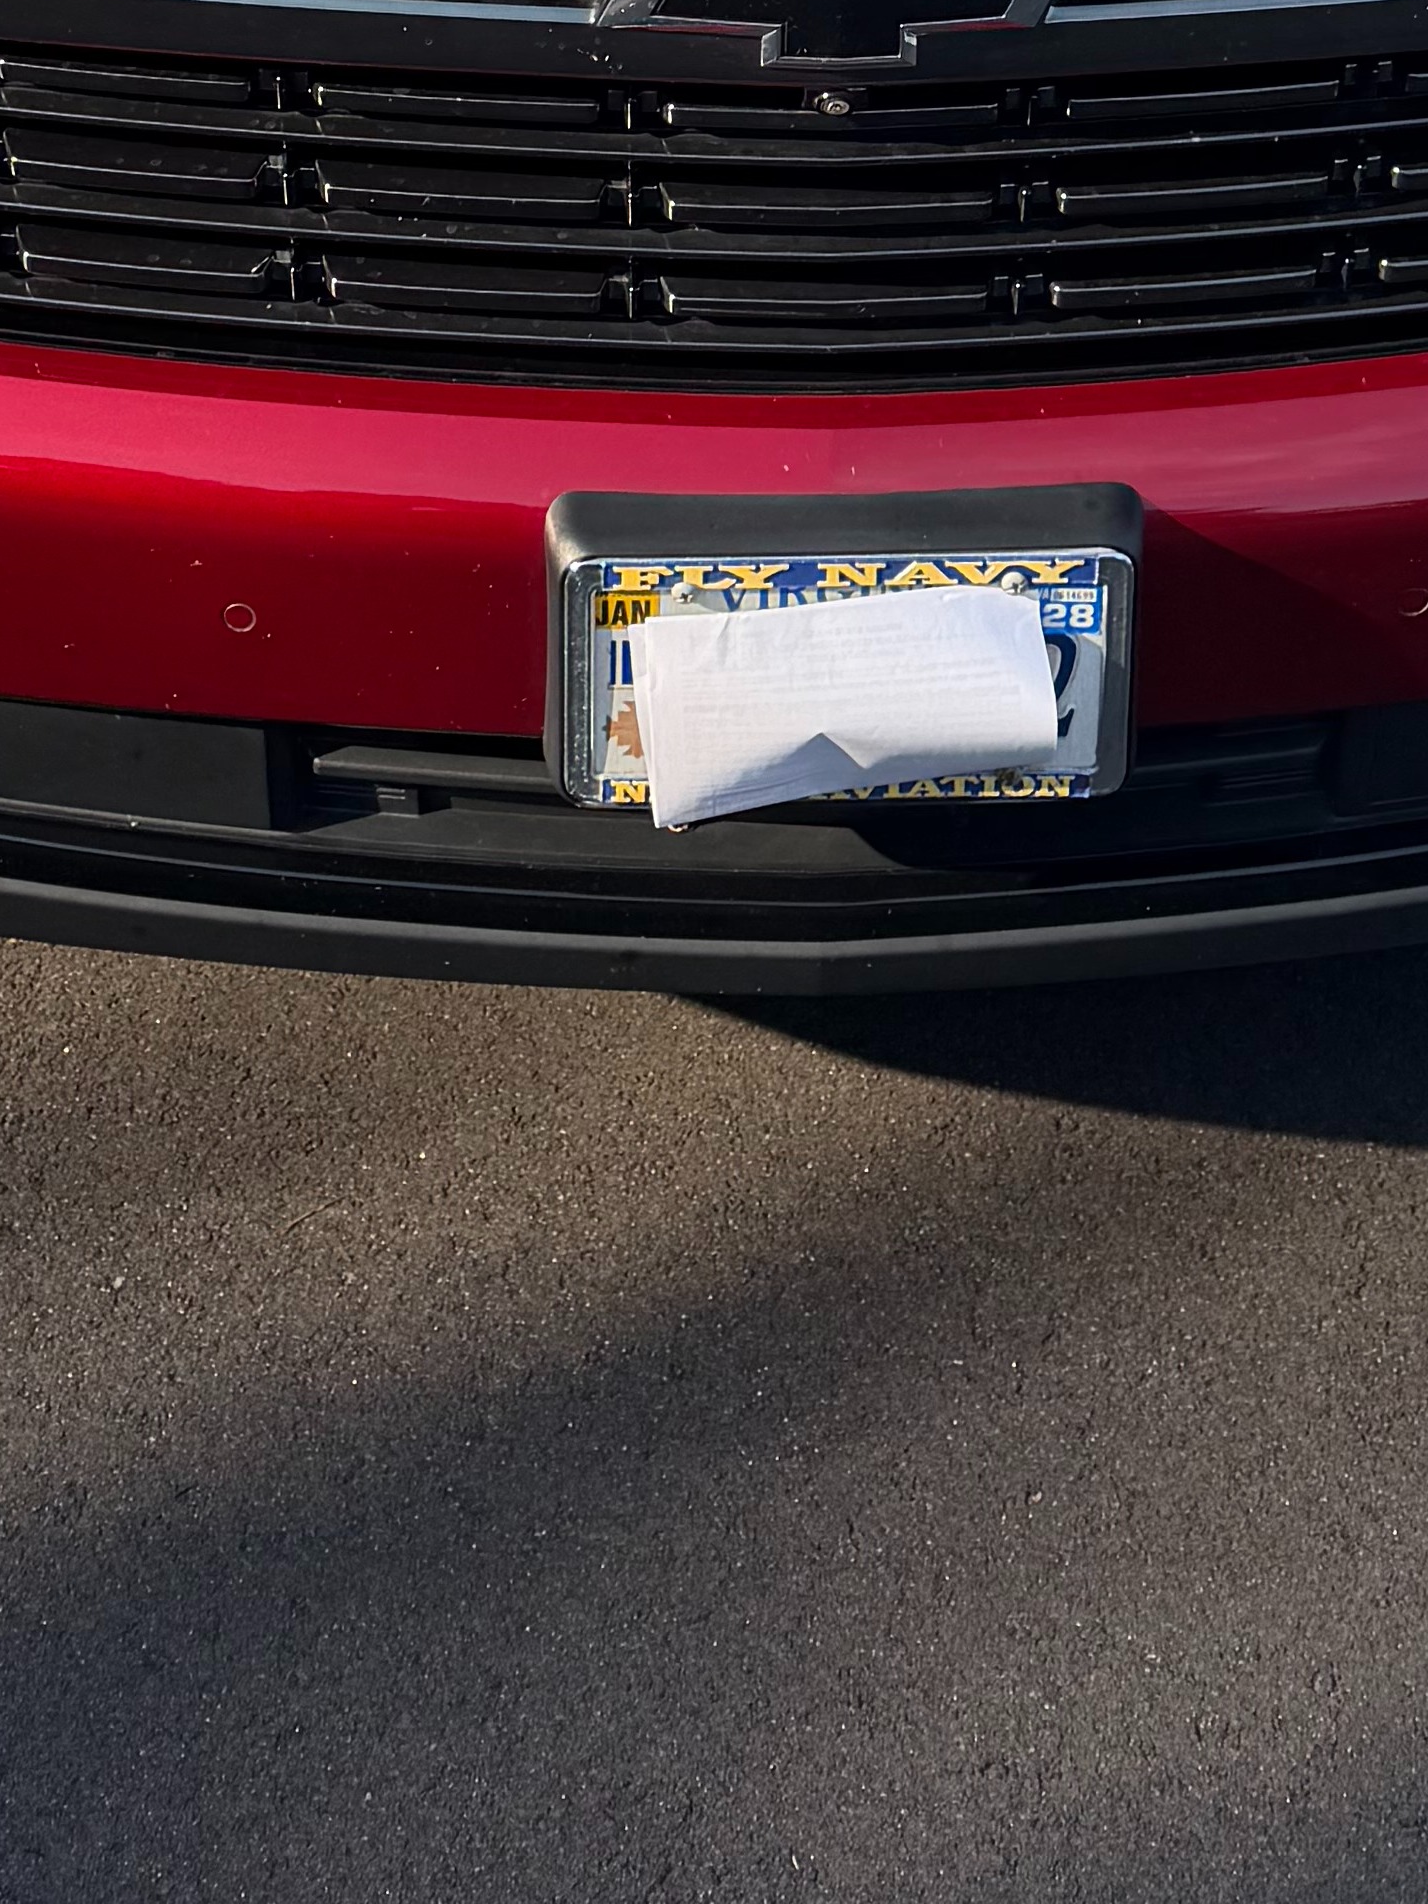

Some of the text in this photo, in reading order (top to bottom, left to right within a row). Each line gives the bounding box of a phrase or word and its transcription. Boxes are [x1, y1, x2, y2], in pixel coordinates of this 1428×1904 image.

[613, 558, 1085, 591] FLY NAVY
[596, 600, 650, 625] JAN
[1043, 604, 1095, 628] 28
